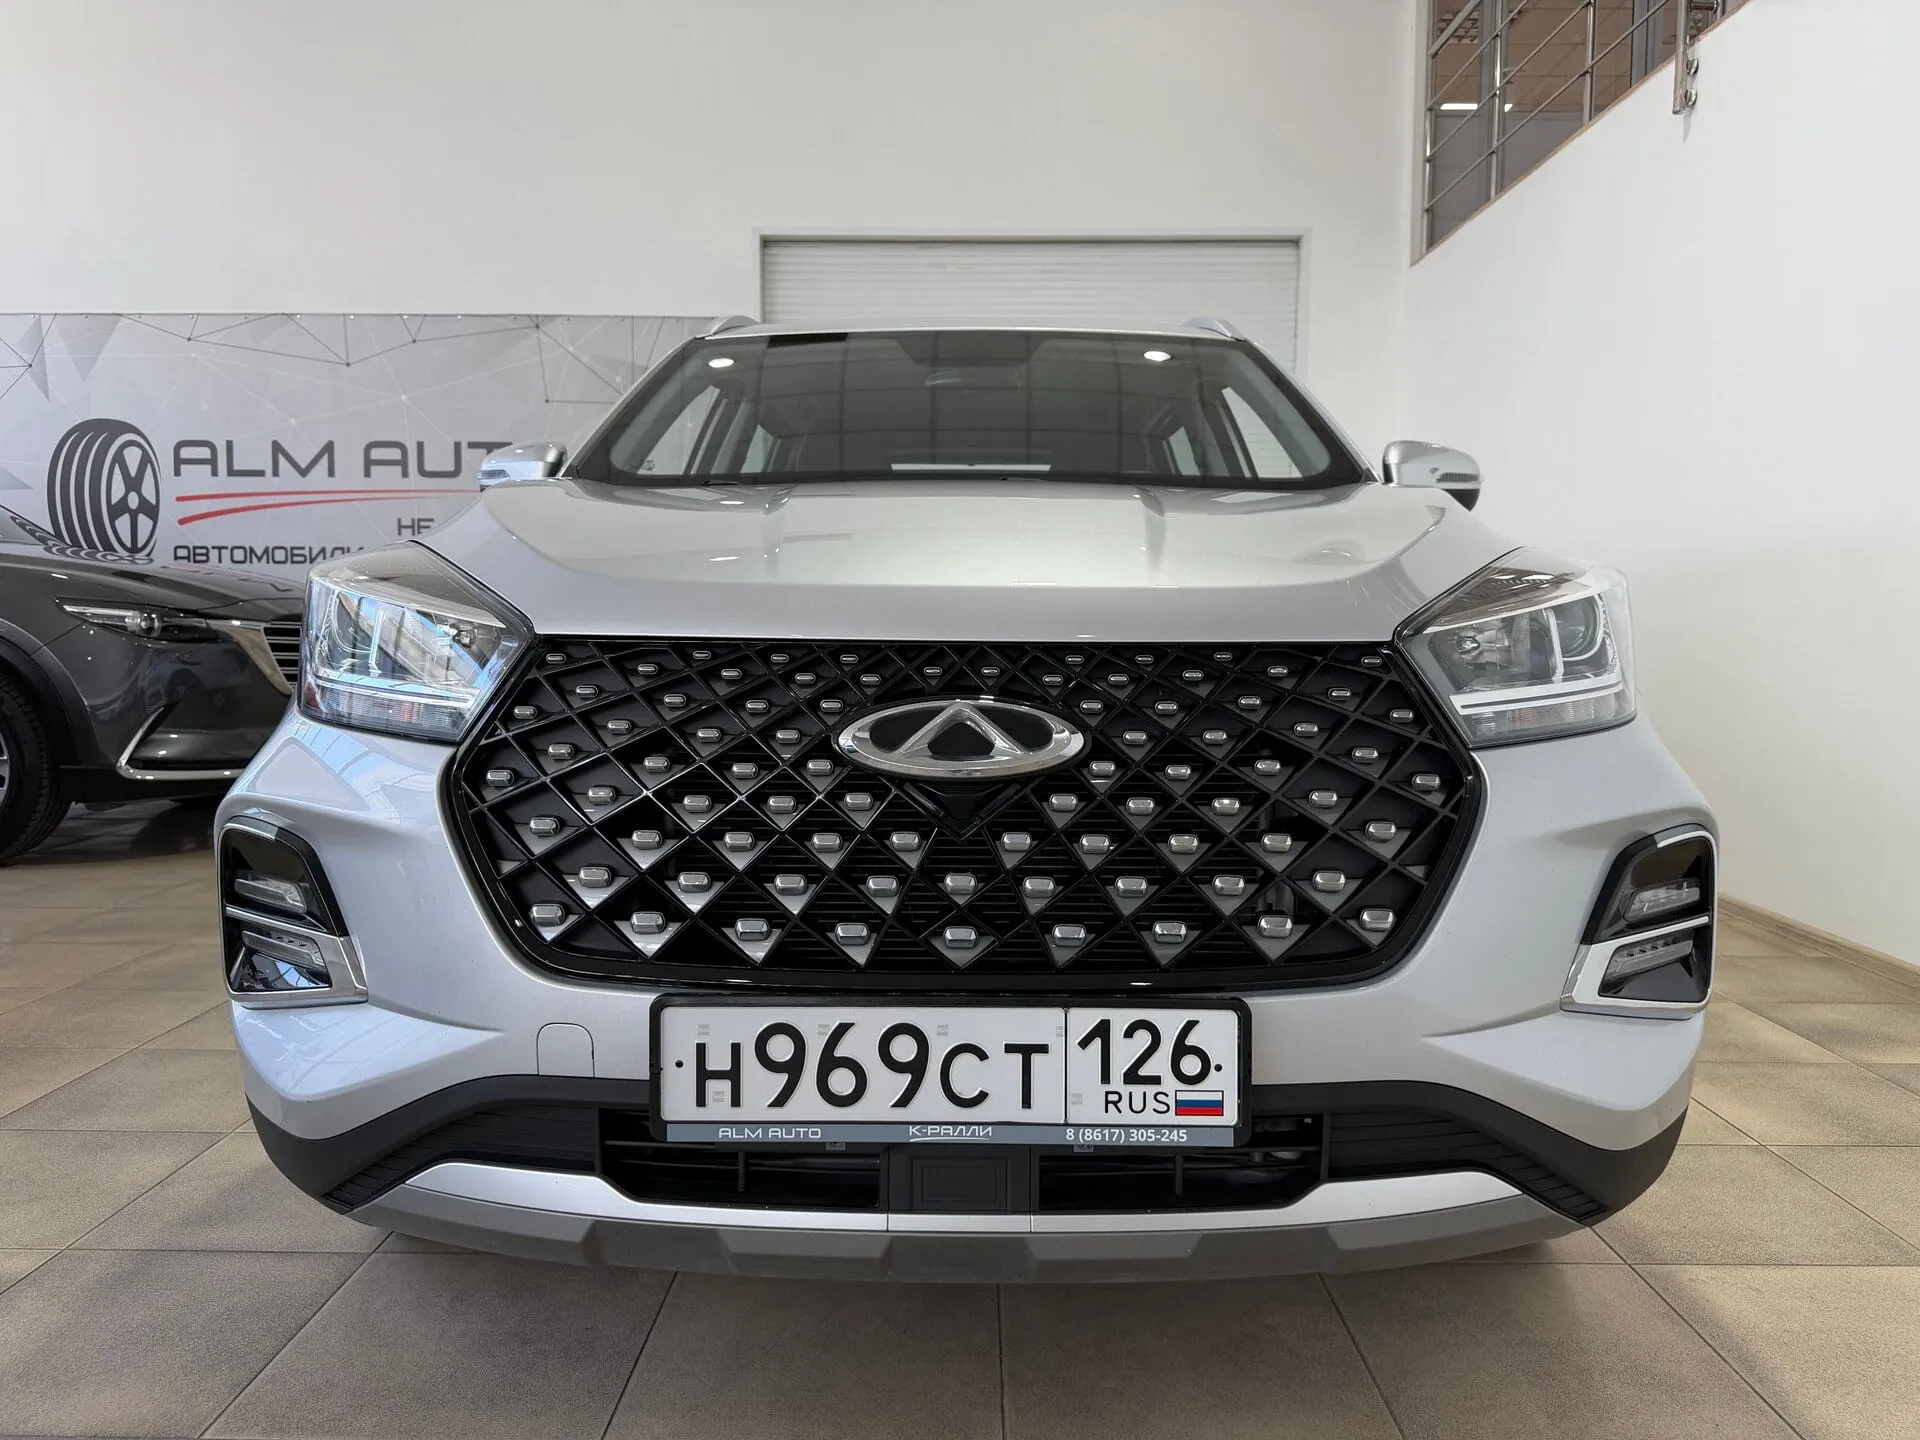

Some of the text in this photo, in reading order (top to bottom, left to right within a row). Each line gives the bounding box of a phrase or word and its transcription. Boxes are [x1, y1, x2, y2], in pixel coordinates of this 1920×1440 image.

[173, 439, 335, 477] ALM
[695, 1019, 1211, 1108] Н969СТ 126
[1104, 1090, 1170, 1114] RUS
[718, 1127, 821, 1139] ALM AUTO
[909, 1125, 992, 1137] К-РАЛЛИ
[1065, 1129, 1187, 1143] 8 (8617) 305-245
